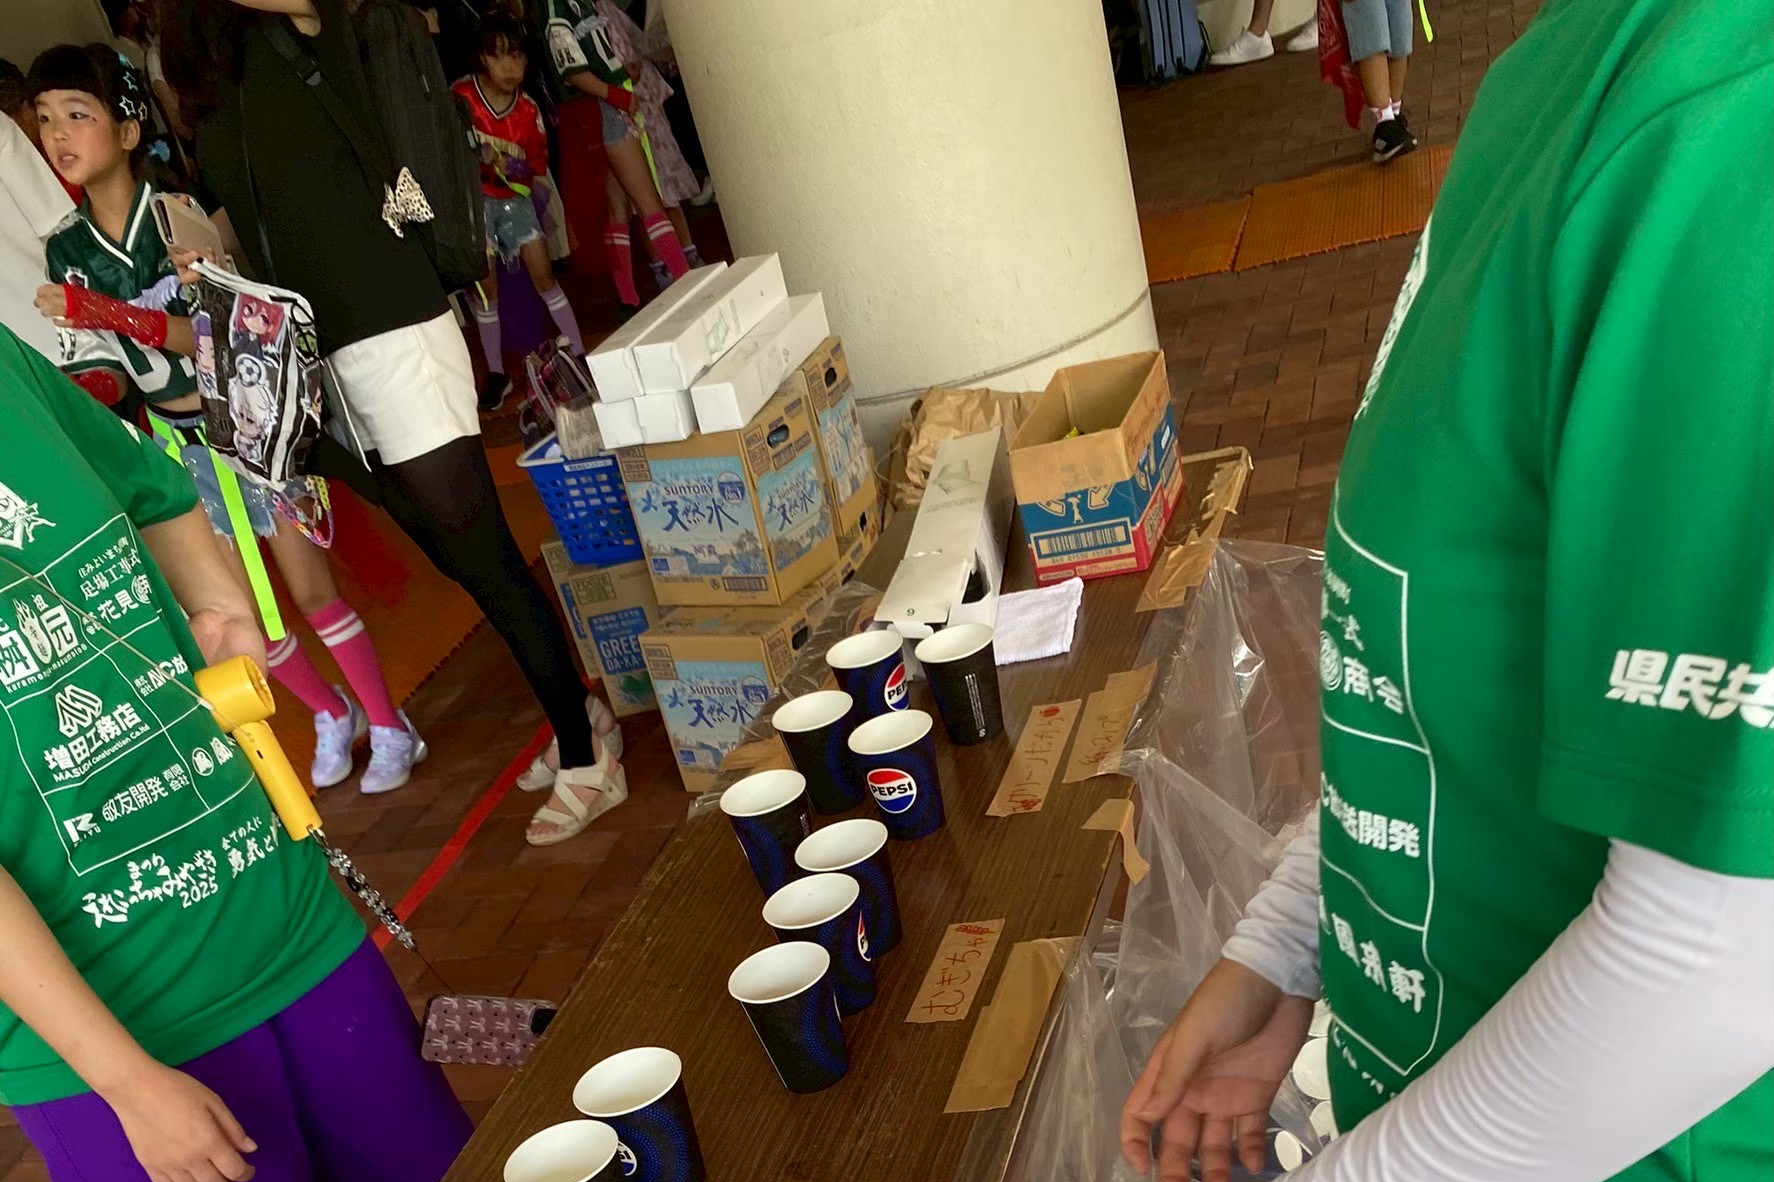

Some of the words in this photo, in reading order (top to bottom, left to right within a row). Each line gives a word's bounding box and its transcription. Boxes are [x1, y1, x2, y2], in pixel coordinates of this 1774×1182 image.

[664, 484, 714, 495] SUNTORY
[661, 498, 739, 532] 天然水
[778, 491, 814, 532] 天然水
[97, 589, 139, 624] 花見
[600, 634, 642, 660] GREE
[689, 685, 738, 696] SUNTORY
[687, 699, 755, 729] 天然水
[43, 702, 142, 771] 増田工務店
[101, 776, 169, 823] 敬友開発
[870, 781, 914, 798] PEPSI
[221, 815, 263, 851] 全ての人に
[126, 853, 166, 879] まつり
[179, 875, 219, 909] 2025
[921, 937, 989, 1016] むぎちゃ
